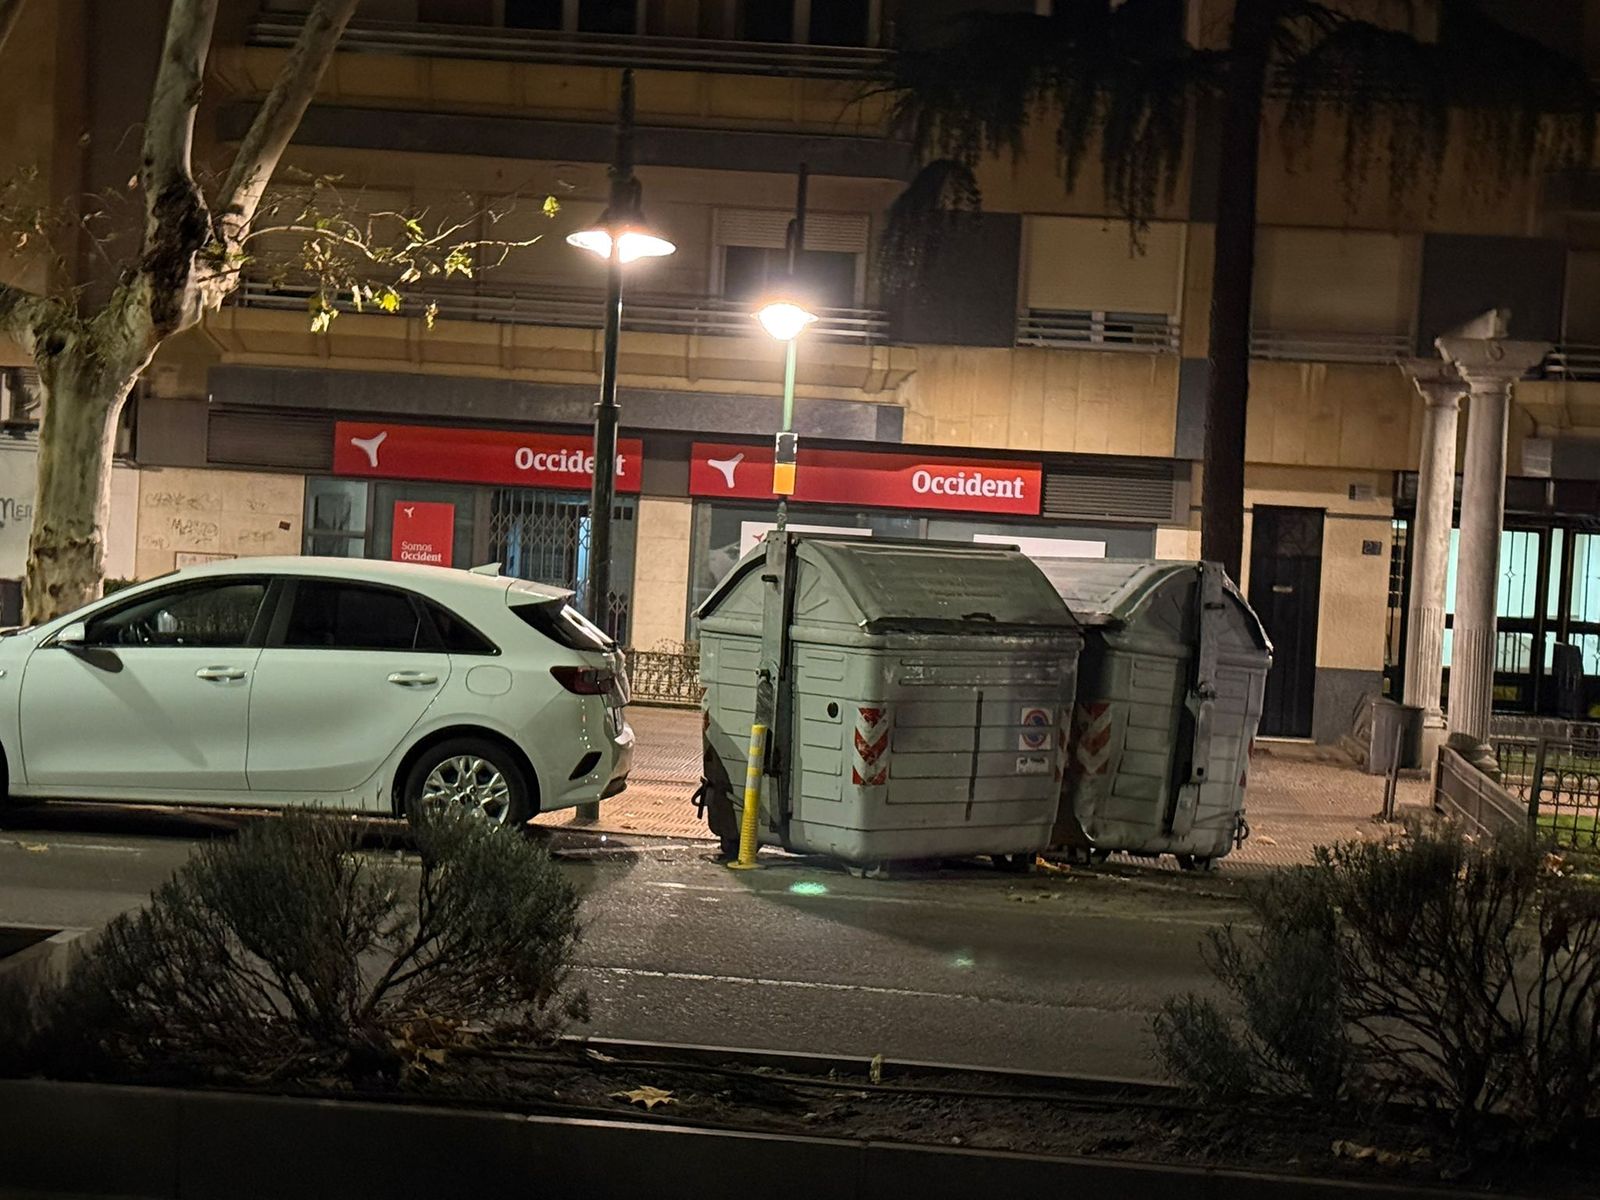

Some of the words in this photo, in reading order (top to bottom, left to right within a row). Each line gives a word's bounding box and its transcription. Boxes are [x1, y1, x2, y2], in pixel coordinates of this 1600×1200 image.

[515, 447, 626, 476] Occidet
[912, 471, 1024, 498] Occident
[402, 541, 432, 552] Somos
[401, 551, 442, 562] Occident
